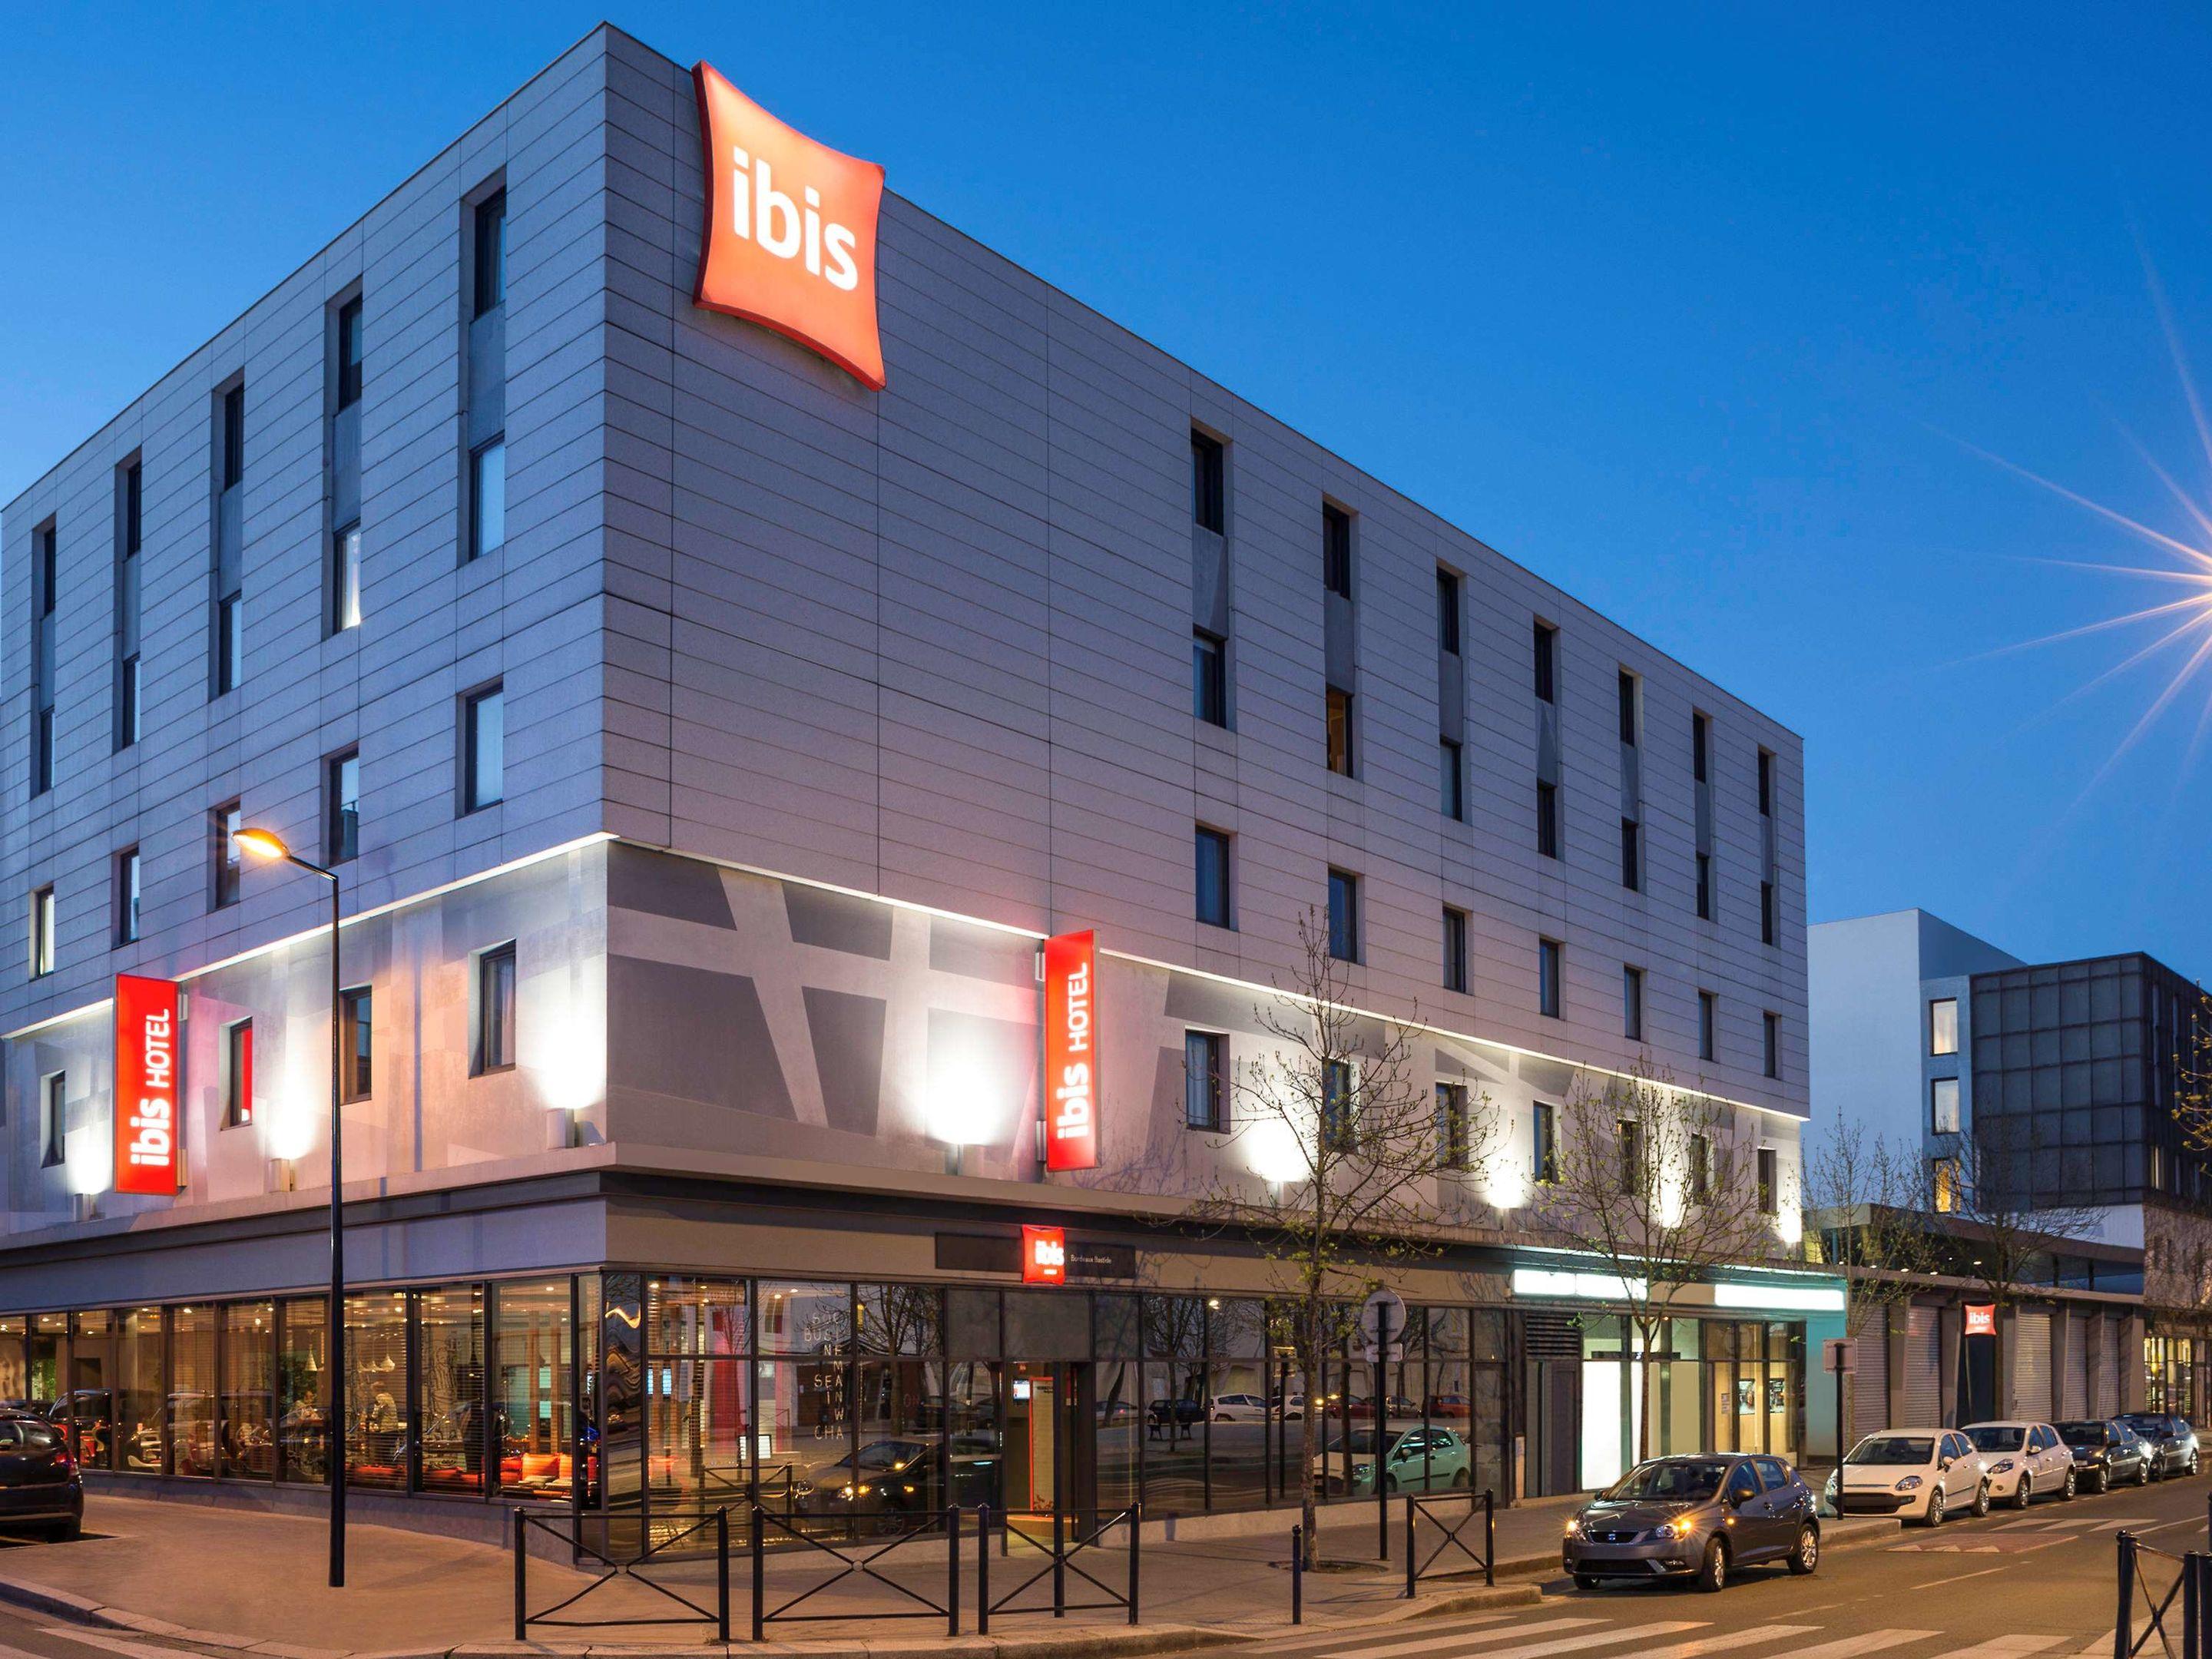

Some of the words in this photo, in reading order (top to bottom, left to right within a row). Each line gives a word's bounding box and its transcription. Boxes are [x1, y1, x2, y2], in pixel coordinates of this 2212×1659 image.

[733, 145, 858, 291] ibis
[1068, 962, 1088, 1052] HOTEL
[145, 1008, 170, 1088] HOTEL
[130, 1098, 170, 1167] ibis
[1056, 1062, 1089, 1139] ibis
[1969, 1312, 1991, 1324] ibis
